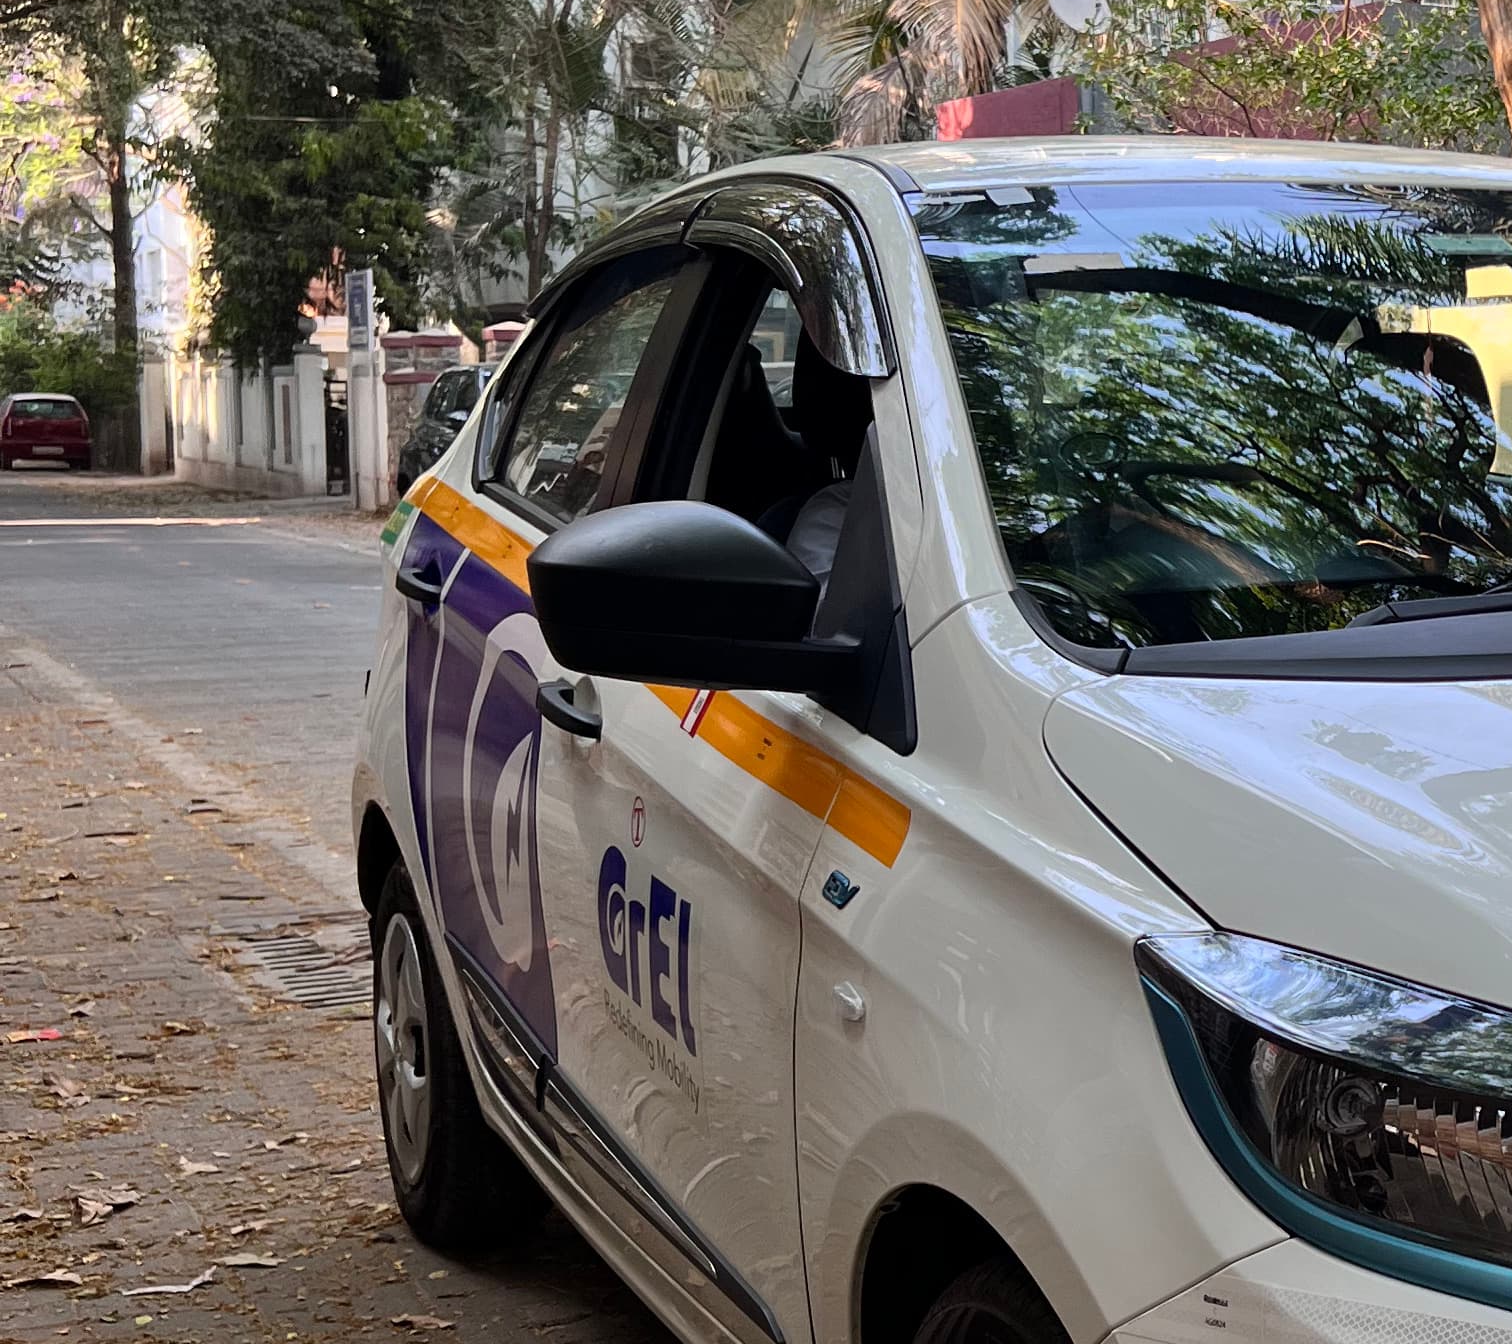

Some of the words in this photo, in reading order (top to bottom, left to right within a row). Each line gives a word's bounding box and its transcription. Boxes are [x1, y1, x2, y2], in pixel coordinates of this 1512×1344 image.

[633, 806, 645, 844] T
[604, 987, 656, 1071] Redefining
[655, 1038, 700, 1116] Mobility
